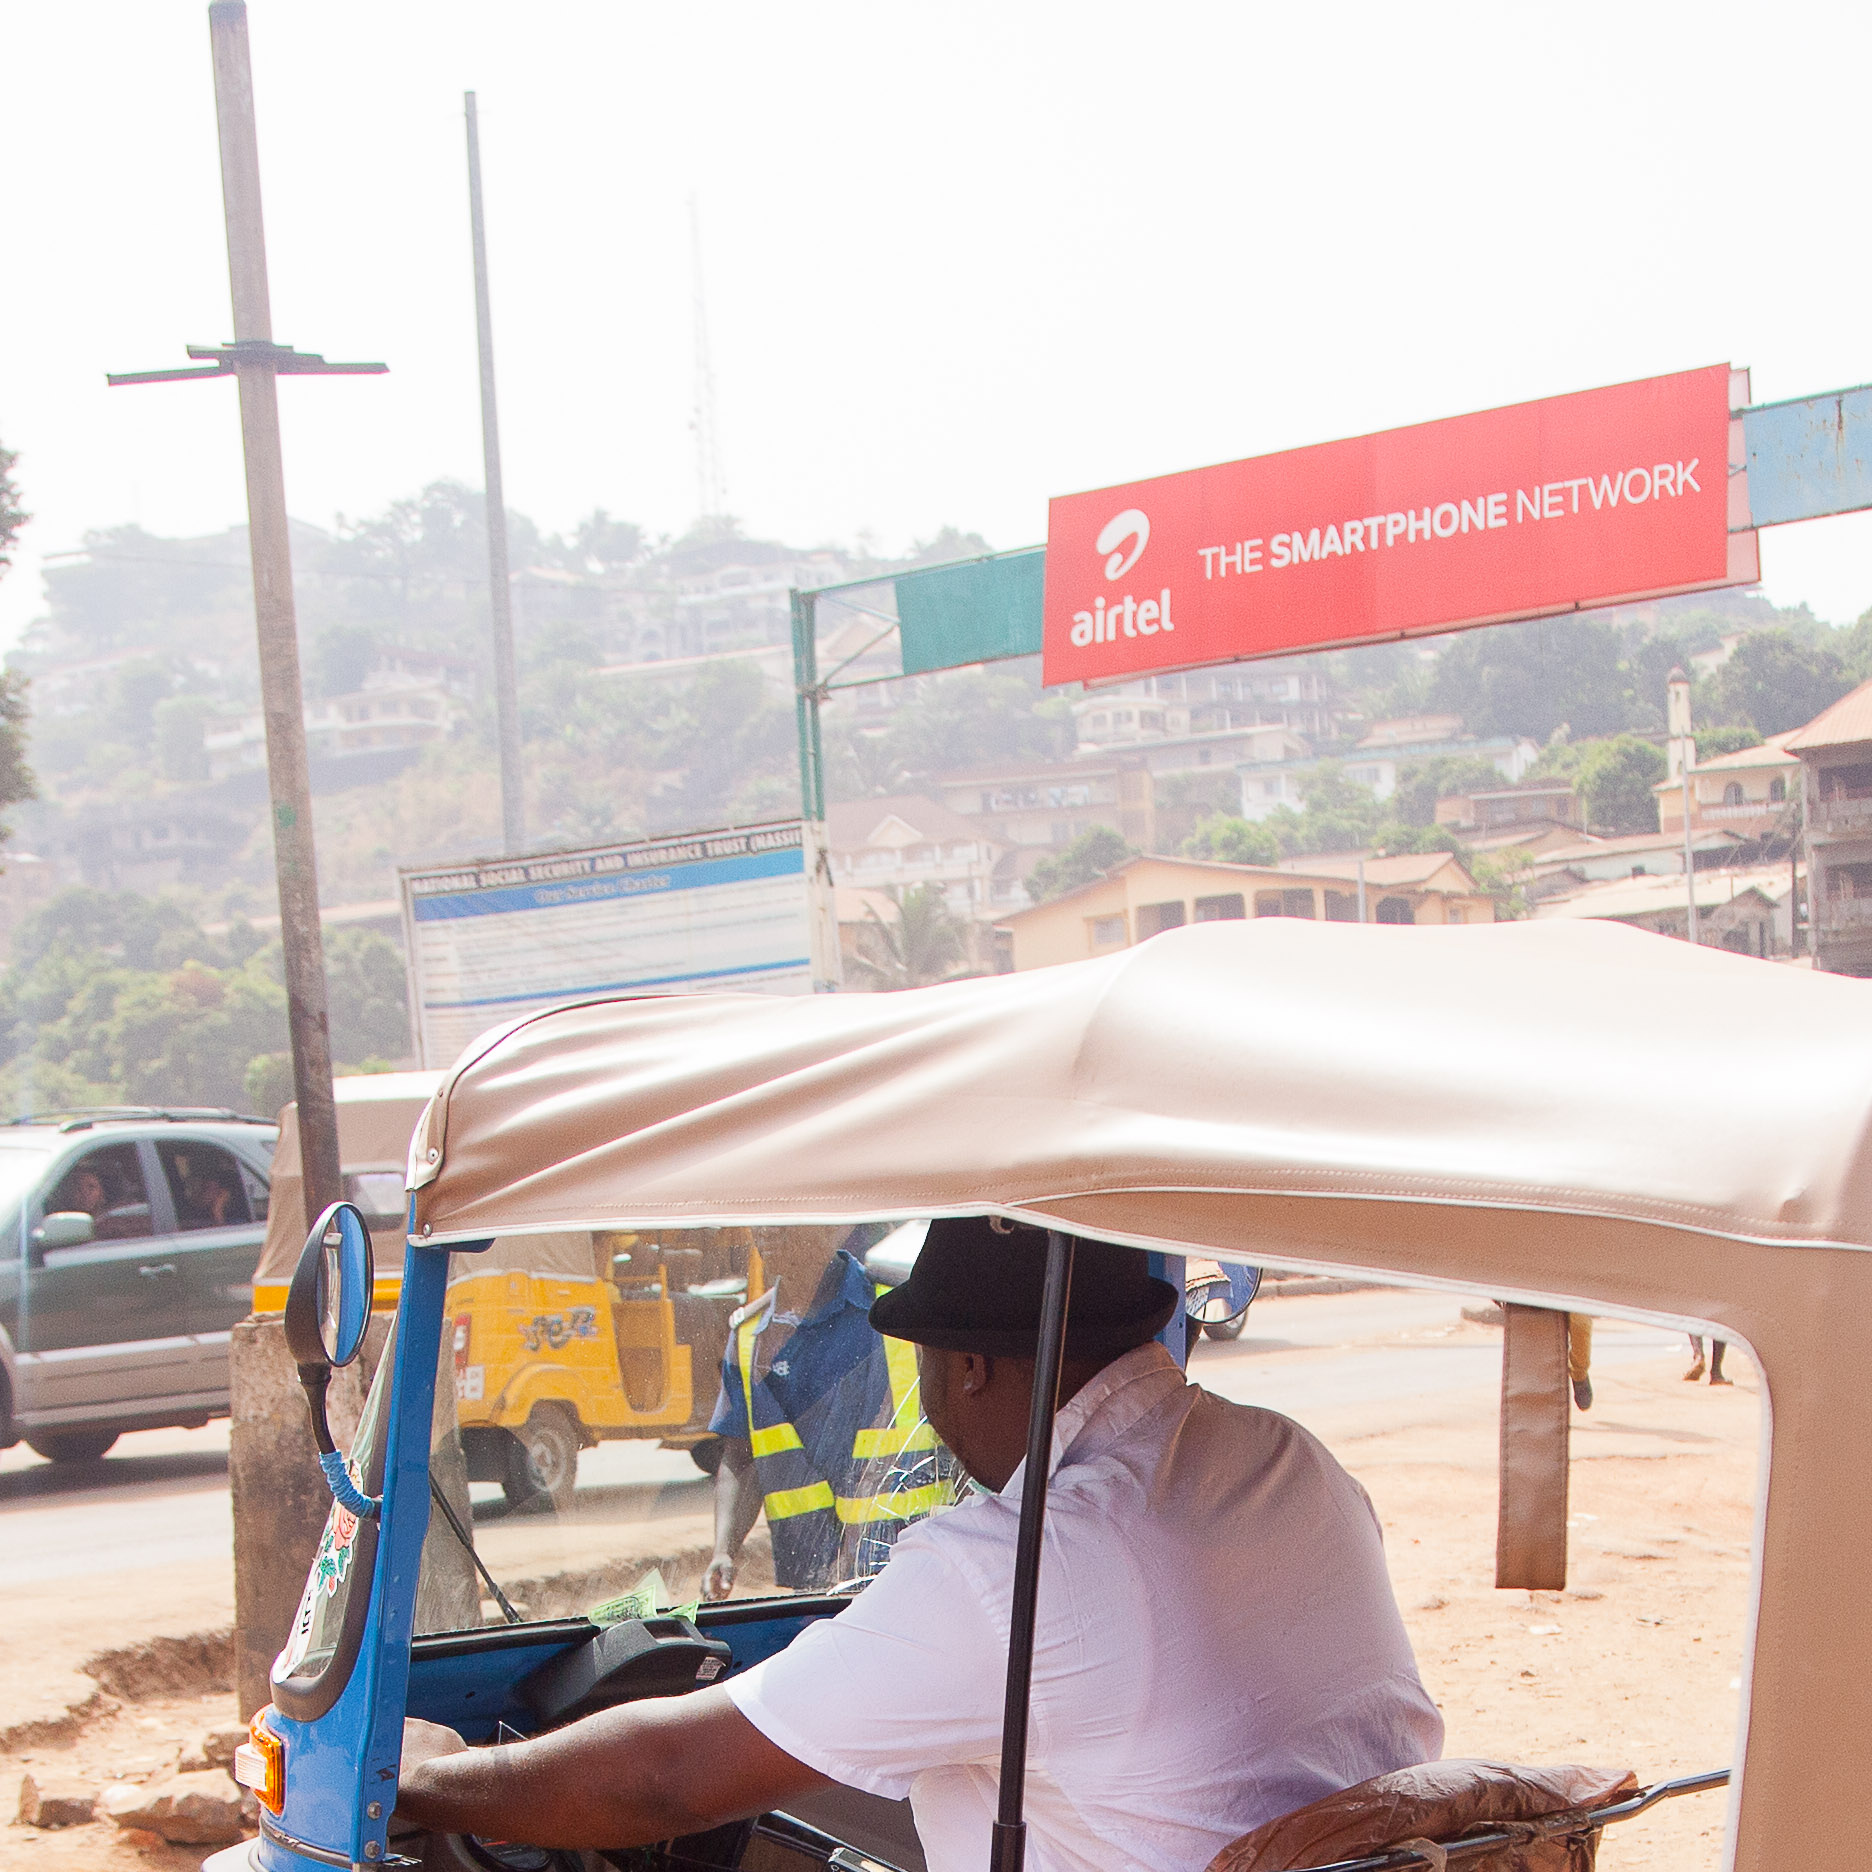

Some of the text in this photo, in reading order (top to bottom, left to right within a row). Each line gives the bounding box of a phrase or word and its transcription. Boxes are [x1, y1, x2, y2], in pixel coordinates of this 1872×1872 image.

[1197, 457, 1701, 580] THE SMARTPHONE NETWORK
[1070, 587, 1174, 647] airtel
[479, 867, 526, 888] SOCIAL
[528, 860, 592, 881] SECURITY
[595, 855, 625, 873] AND
[628, 844, 703, 868] INSURANCE
[705, 836, 749, 857] TRUST
